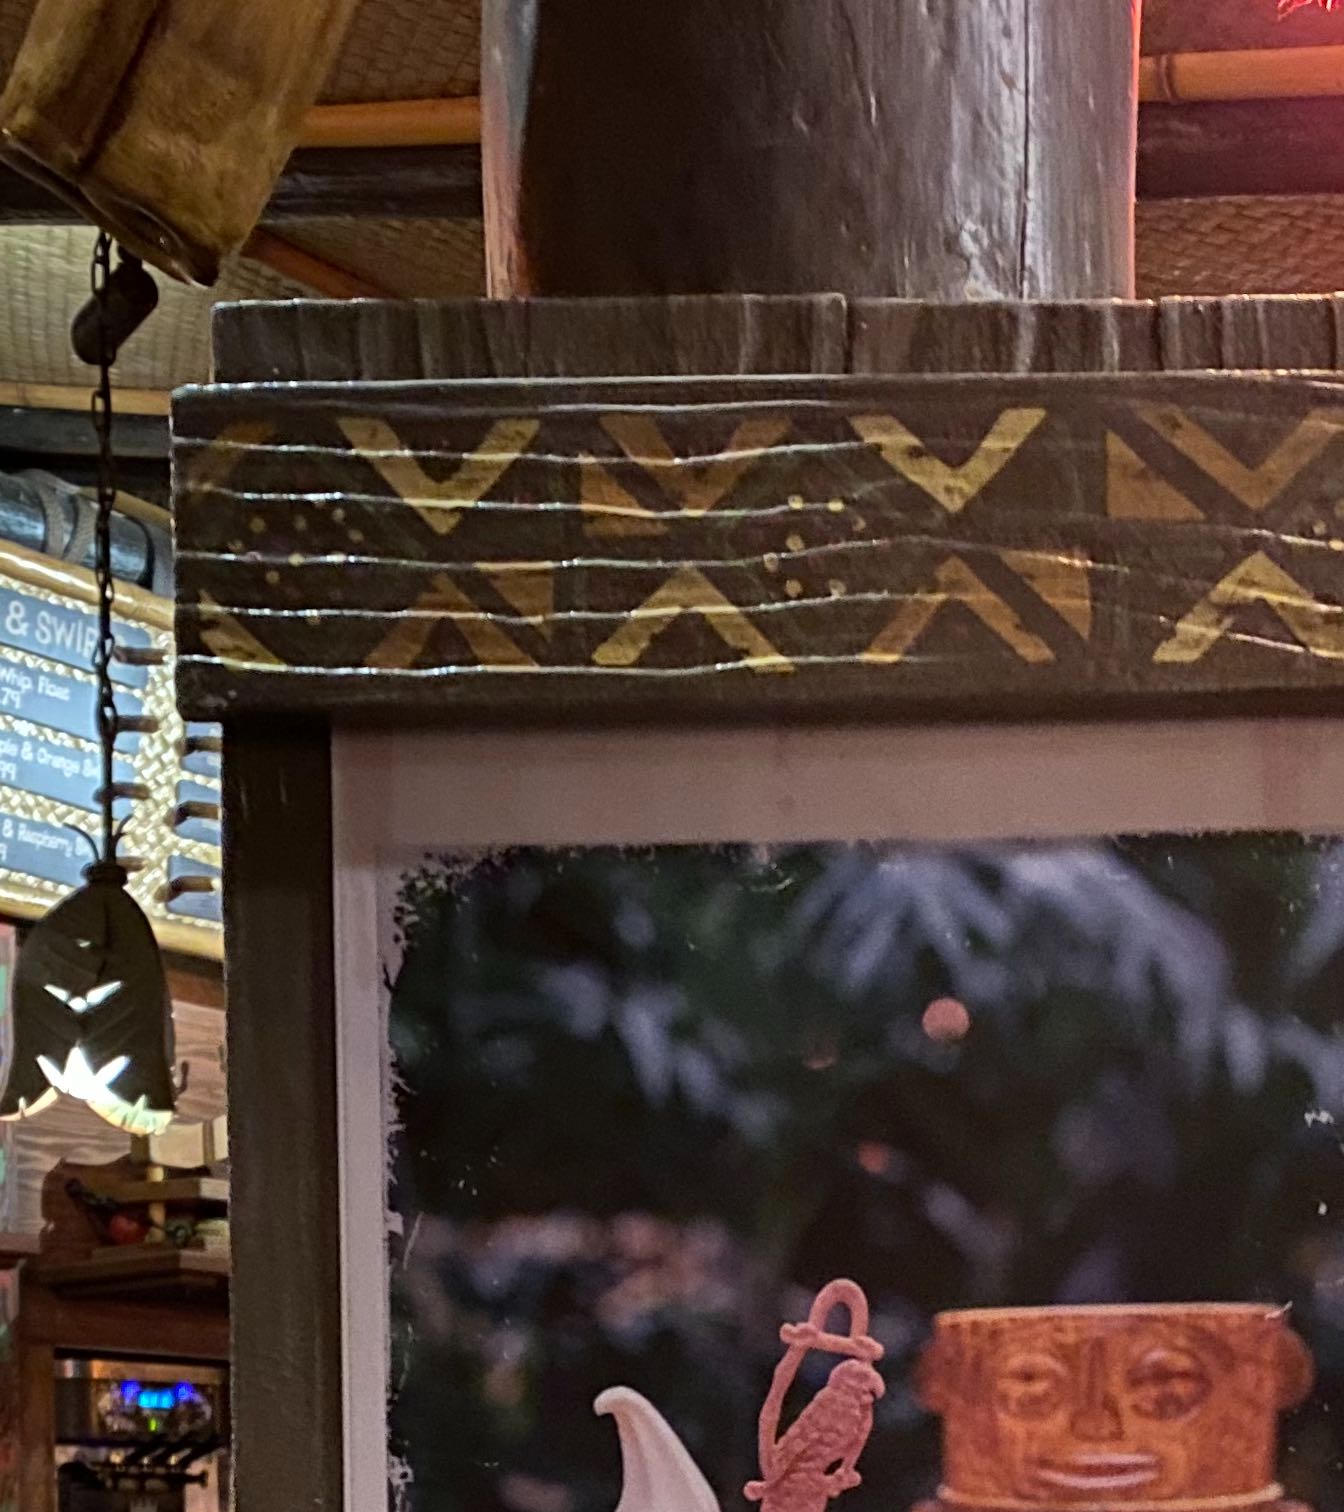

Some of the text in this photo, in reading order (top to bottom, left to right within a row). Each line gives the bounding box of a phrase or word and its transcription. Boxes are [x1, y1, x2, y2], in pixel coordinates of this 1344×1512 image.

[6, 601, 29, 636] &
[35, 611, 124, 662] SWIR
[21, 741, 34, 761] &
[37, 746, 80, 778] Orange
